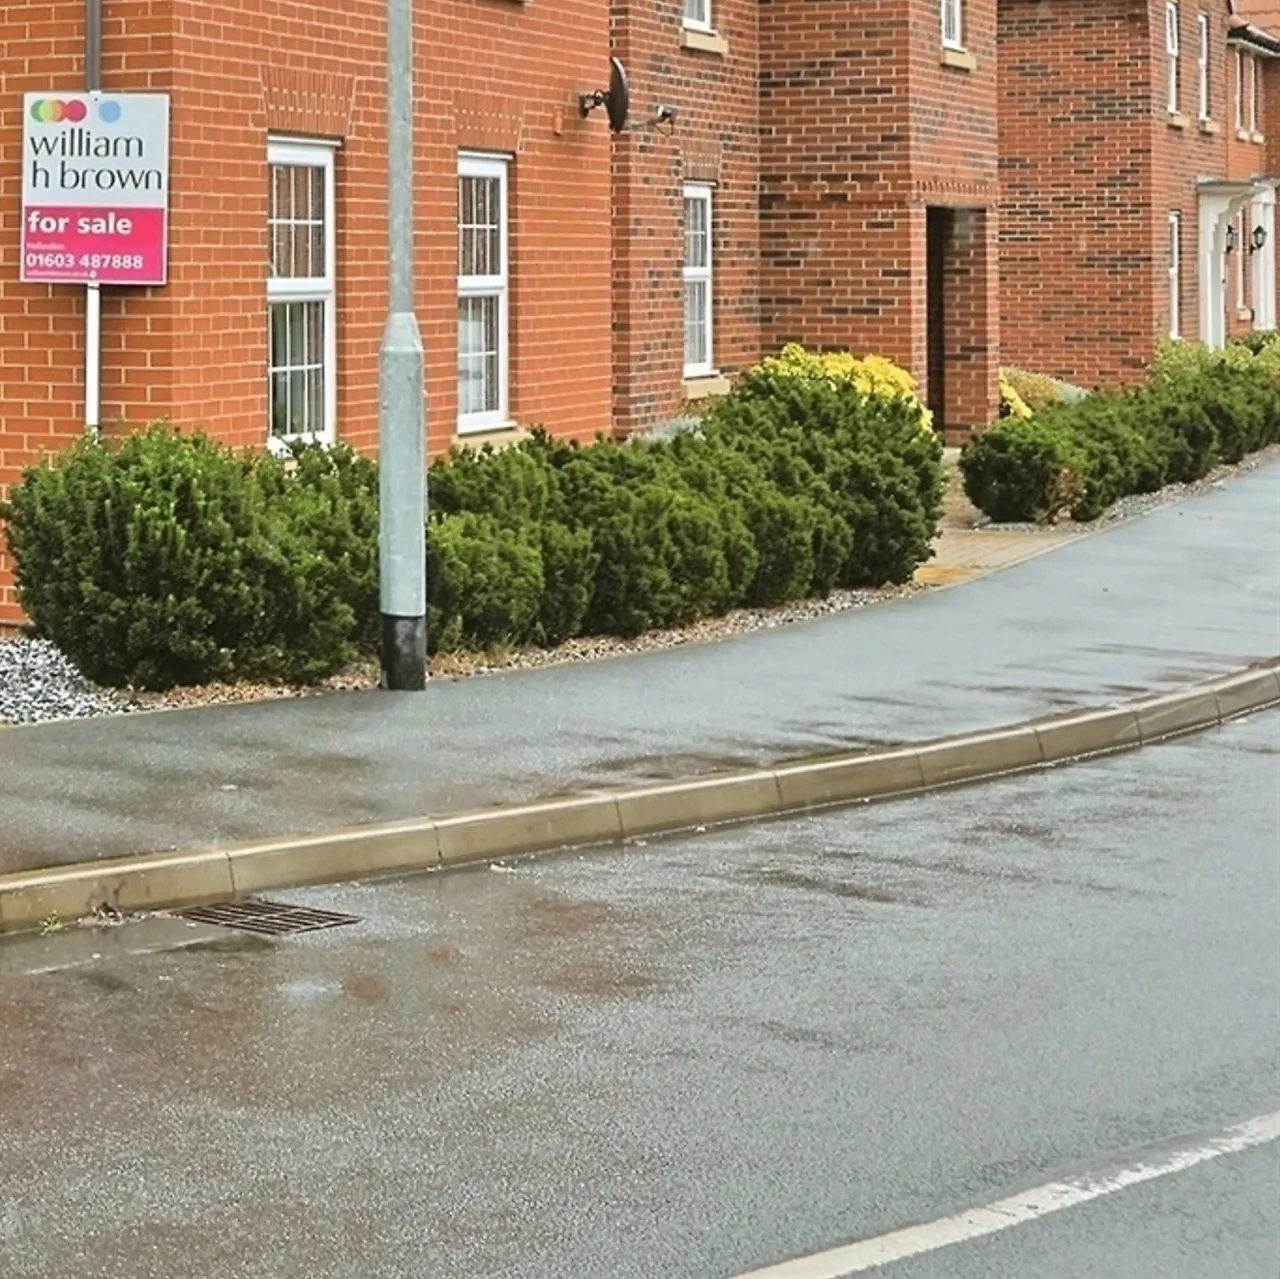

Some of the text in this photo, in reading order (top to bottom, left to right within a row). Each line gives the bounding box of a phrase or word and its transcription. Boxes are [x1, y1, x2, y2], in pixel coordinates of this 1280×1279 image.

[29, 128, 143, 158] william
[32, 160, 163, 190] h brown
[27, 210, 133, 235] for sale
[26, 253, 144, 270] 01603 487888
